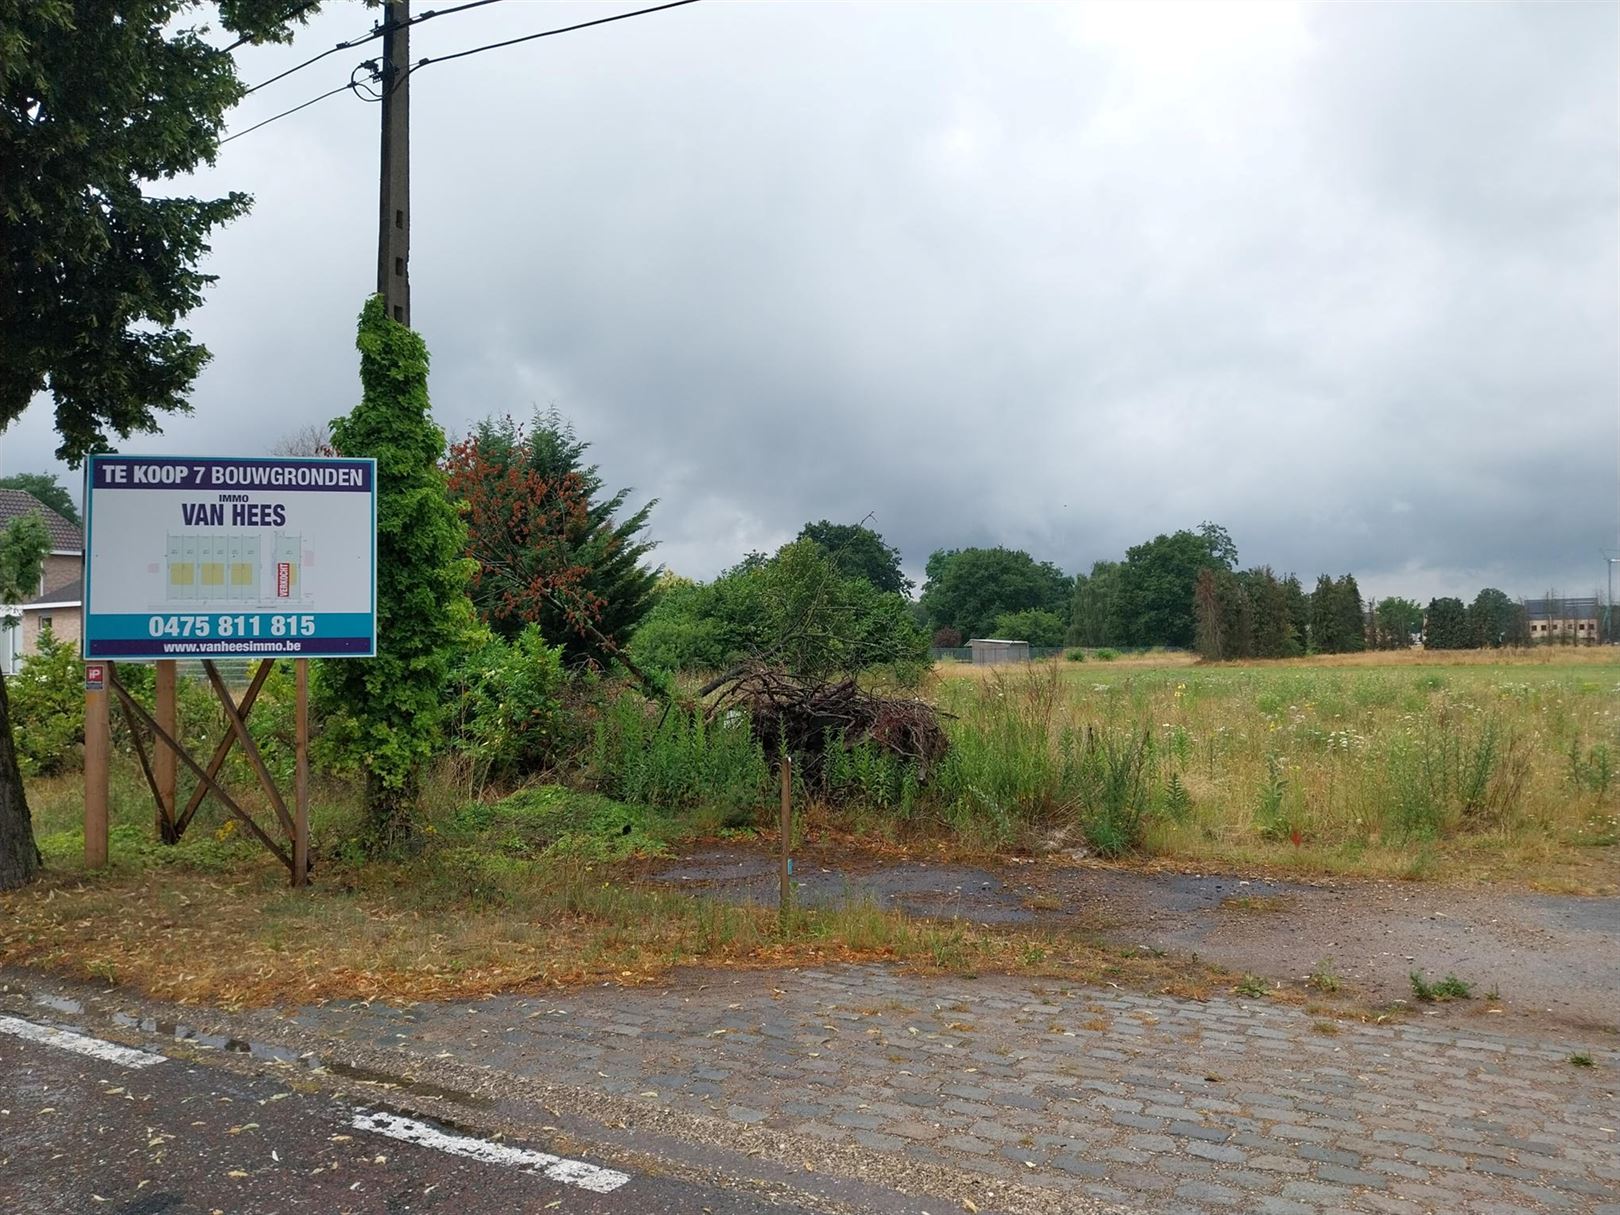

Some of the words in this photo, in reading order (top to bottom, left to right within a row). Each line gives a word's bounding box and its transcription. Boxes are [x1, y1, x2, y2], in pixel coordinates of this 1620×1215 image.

[102, 464, 127, 483] TE
[133, 464, 188, 484] KOOP
[194, 466, 205, 485] 7
[211, 466, 363, 487] BOUWGRONDEN
[218, 494, 249, 503] IMMO
[182, 503, 224, 526] VAN
[232, 503, 286, 527] HEES
[279, 564, 289, 597] VERKOCHT
[148, 616, 210, 637] 0475
[218, 616, 260, 637] 811
[271, 616, 315, 637] 815
[163, 641, 301, 653] www.vanheesimmo.be
